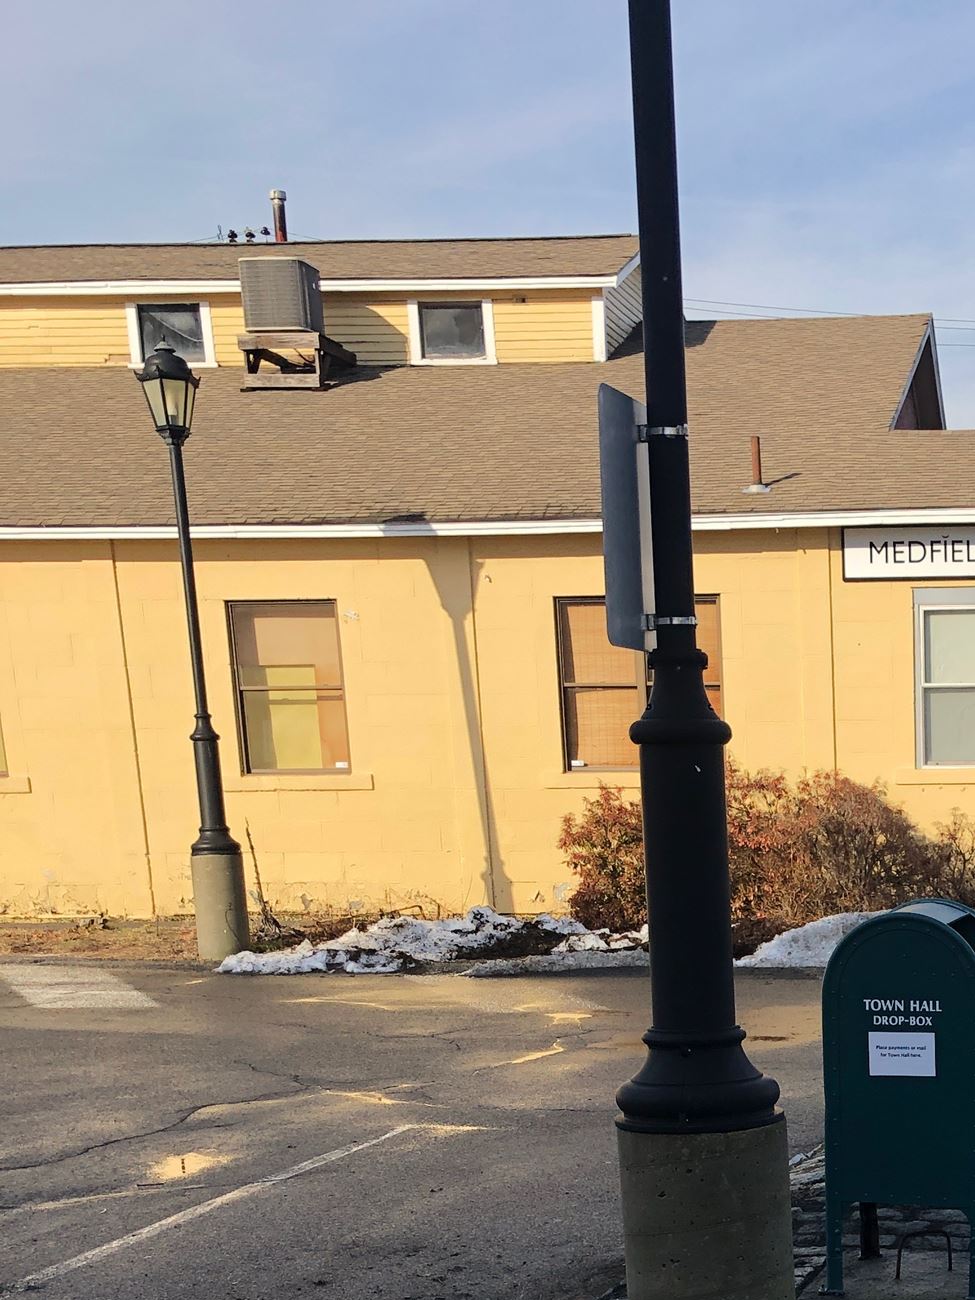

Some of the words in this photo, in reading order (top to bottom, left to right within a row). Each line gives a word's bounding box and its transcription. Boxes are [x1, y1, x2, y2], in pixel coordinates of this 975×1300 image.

[863, 999, 904, 1012] TOWN
[910, 1000, 942, 1012] HALL
[873, 1015, 933, 1026] DROP-BOX
